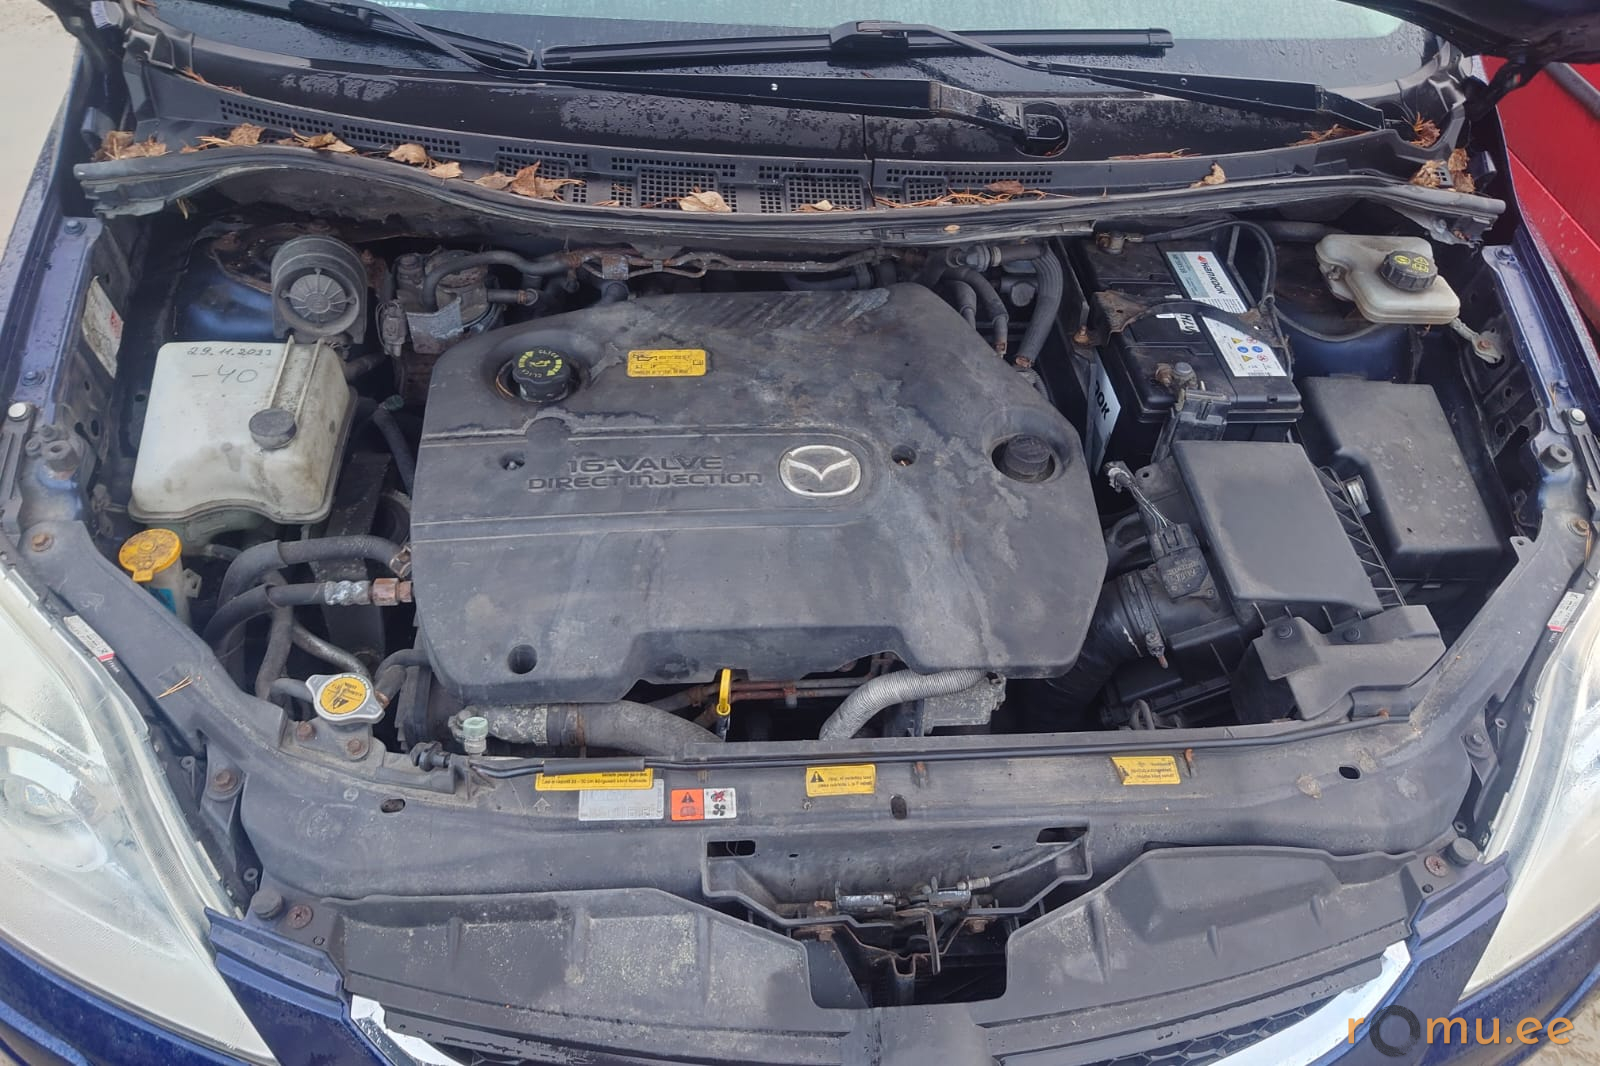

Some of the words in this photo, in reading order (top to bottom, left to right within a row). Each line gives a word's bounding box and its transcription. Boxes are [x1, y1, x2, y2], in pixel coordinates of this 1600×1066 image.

[567, 456, 724, 474] 16-VALVE
[528, 474, 623, 492] DIRECT
[628, 472, 763, 488] INJECTION
